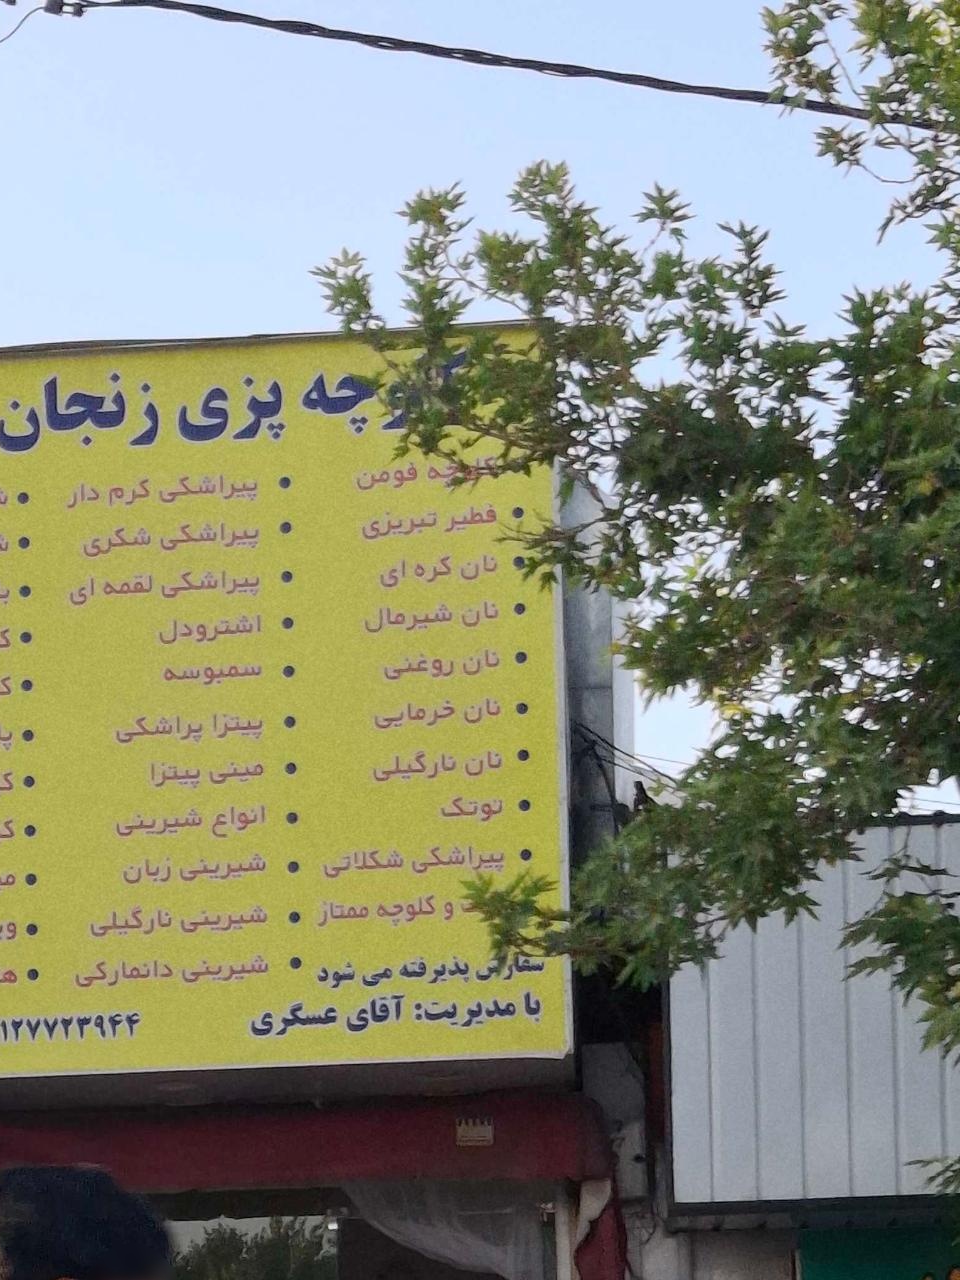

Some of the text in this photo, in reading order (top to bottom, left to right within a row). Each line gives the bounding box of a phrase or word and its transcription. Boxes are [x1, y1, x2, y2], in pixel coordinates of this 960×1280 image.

[178, 374, 285, 441] پزی
[356, 462, 417, 490] فومن
[67, 475, 257, 509] پیراشکی کرم دار
[362, 505, 497, 540] فطیر تبریزی
[83, 523, 259, 558] پیراشکی شکری
[380, 556, 497, 588] نان کره ای
[70, 571, 260, 606] پیراشکی لقمه ای
[159, 615, 261, 645] اشترودل
[365, 602, 498, 633] نان شیرمال
[164, 665, 262, 685] سمبوسه
[384, 650, 500, 680] نان روغنی
[116, 714, 263, 744] پیتزا پراشکی
[374, 698, 501, 729] نان خرمایی
[151, 762, 264, 788] مینی پیتزا
[373, 751, 502, 782] نان نارگیلی
[116, 806, 265, 838] انواع شیرینی
[179, 853, 266, 882] شیرینی
[324, 846, 504, 879] پیراشکی شکلاتی
[90, 906, 268, 937] شیرینی نارگیلی
[318, 903, 369, 927] ممتاز
[376, 894, 436, 926] کلوچه
[75, 955, 269, 988] شیرینی دانمارکی
[317, 962, 355, 988] شود
[362, 964, 392, 986] می
[399, 956, 469, 984] پذیرفته
[250, 991, 541, 1037] با مدیریت: آقای عسگری
